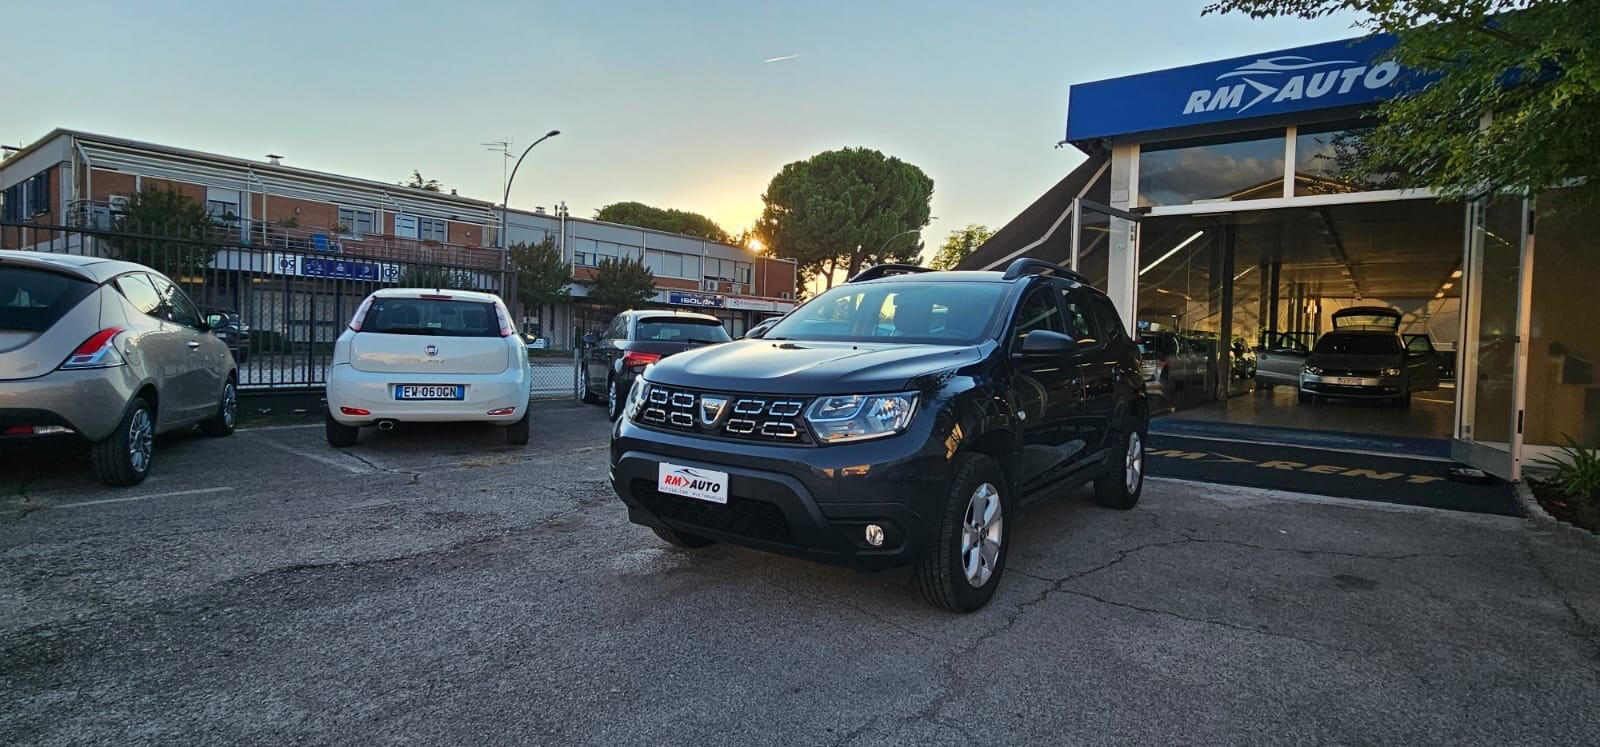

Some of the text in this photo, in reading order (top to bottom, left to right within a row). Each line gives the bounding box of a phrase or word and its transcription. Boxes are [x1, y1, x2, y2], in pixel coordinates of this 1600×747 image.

[1182, 60, 1400, 115] RM AUTO
[664, 475, 683, 486] RM
[689, 479, 721, 493] AUTO
[1254, 459, 1446, 485] RENT
